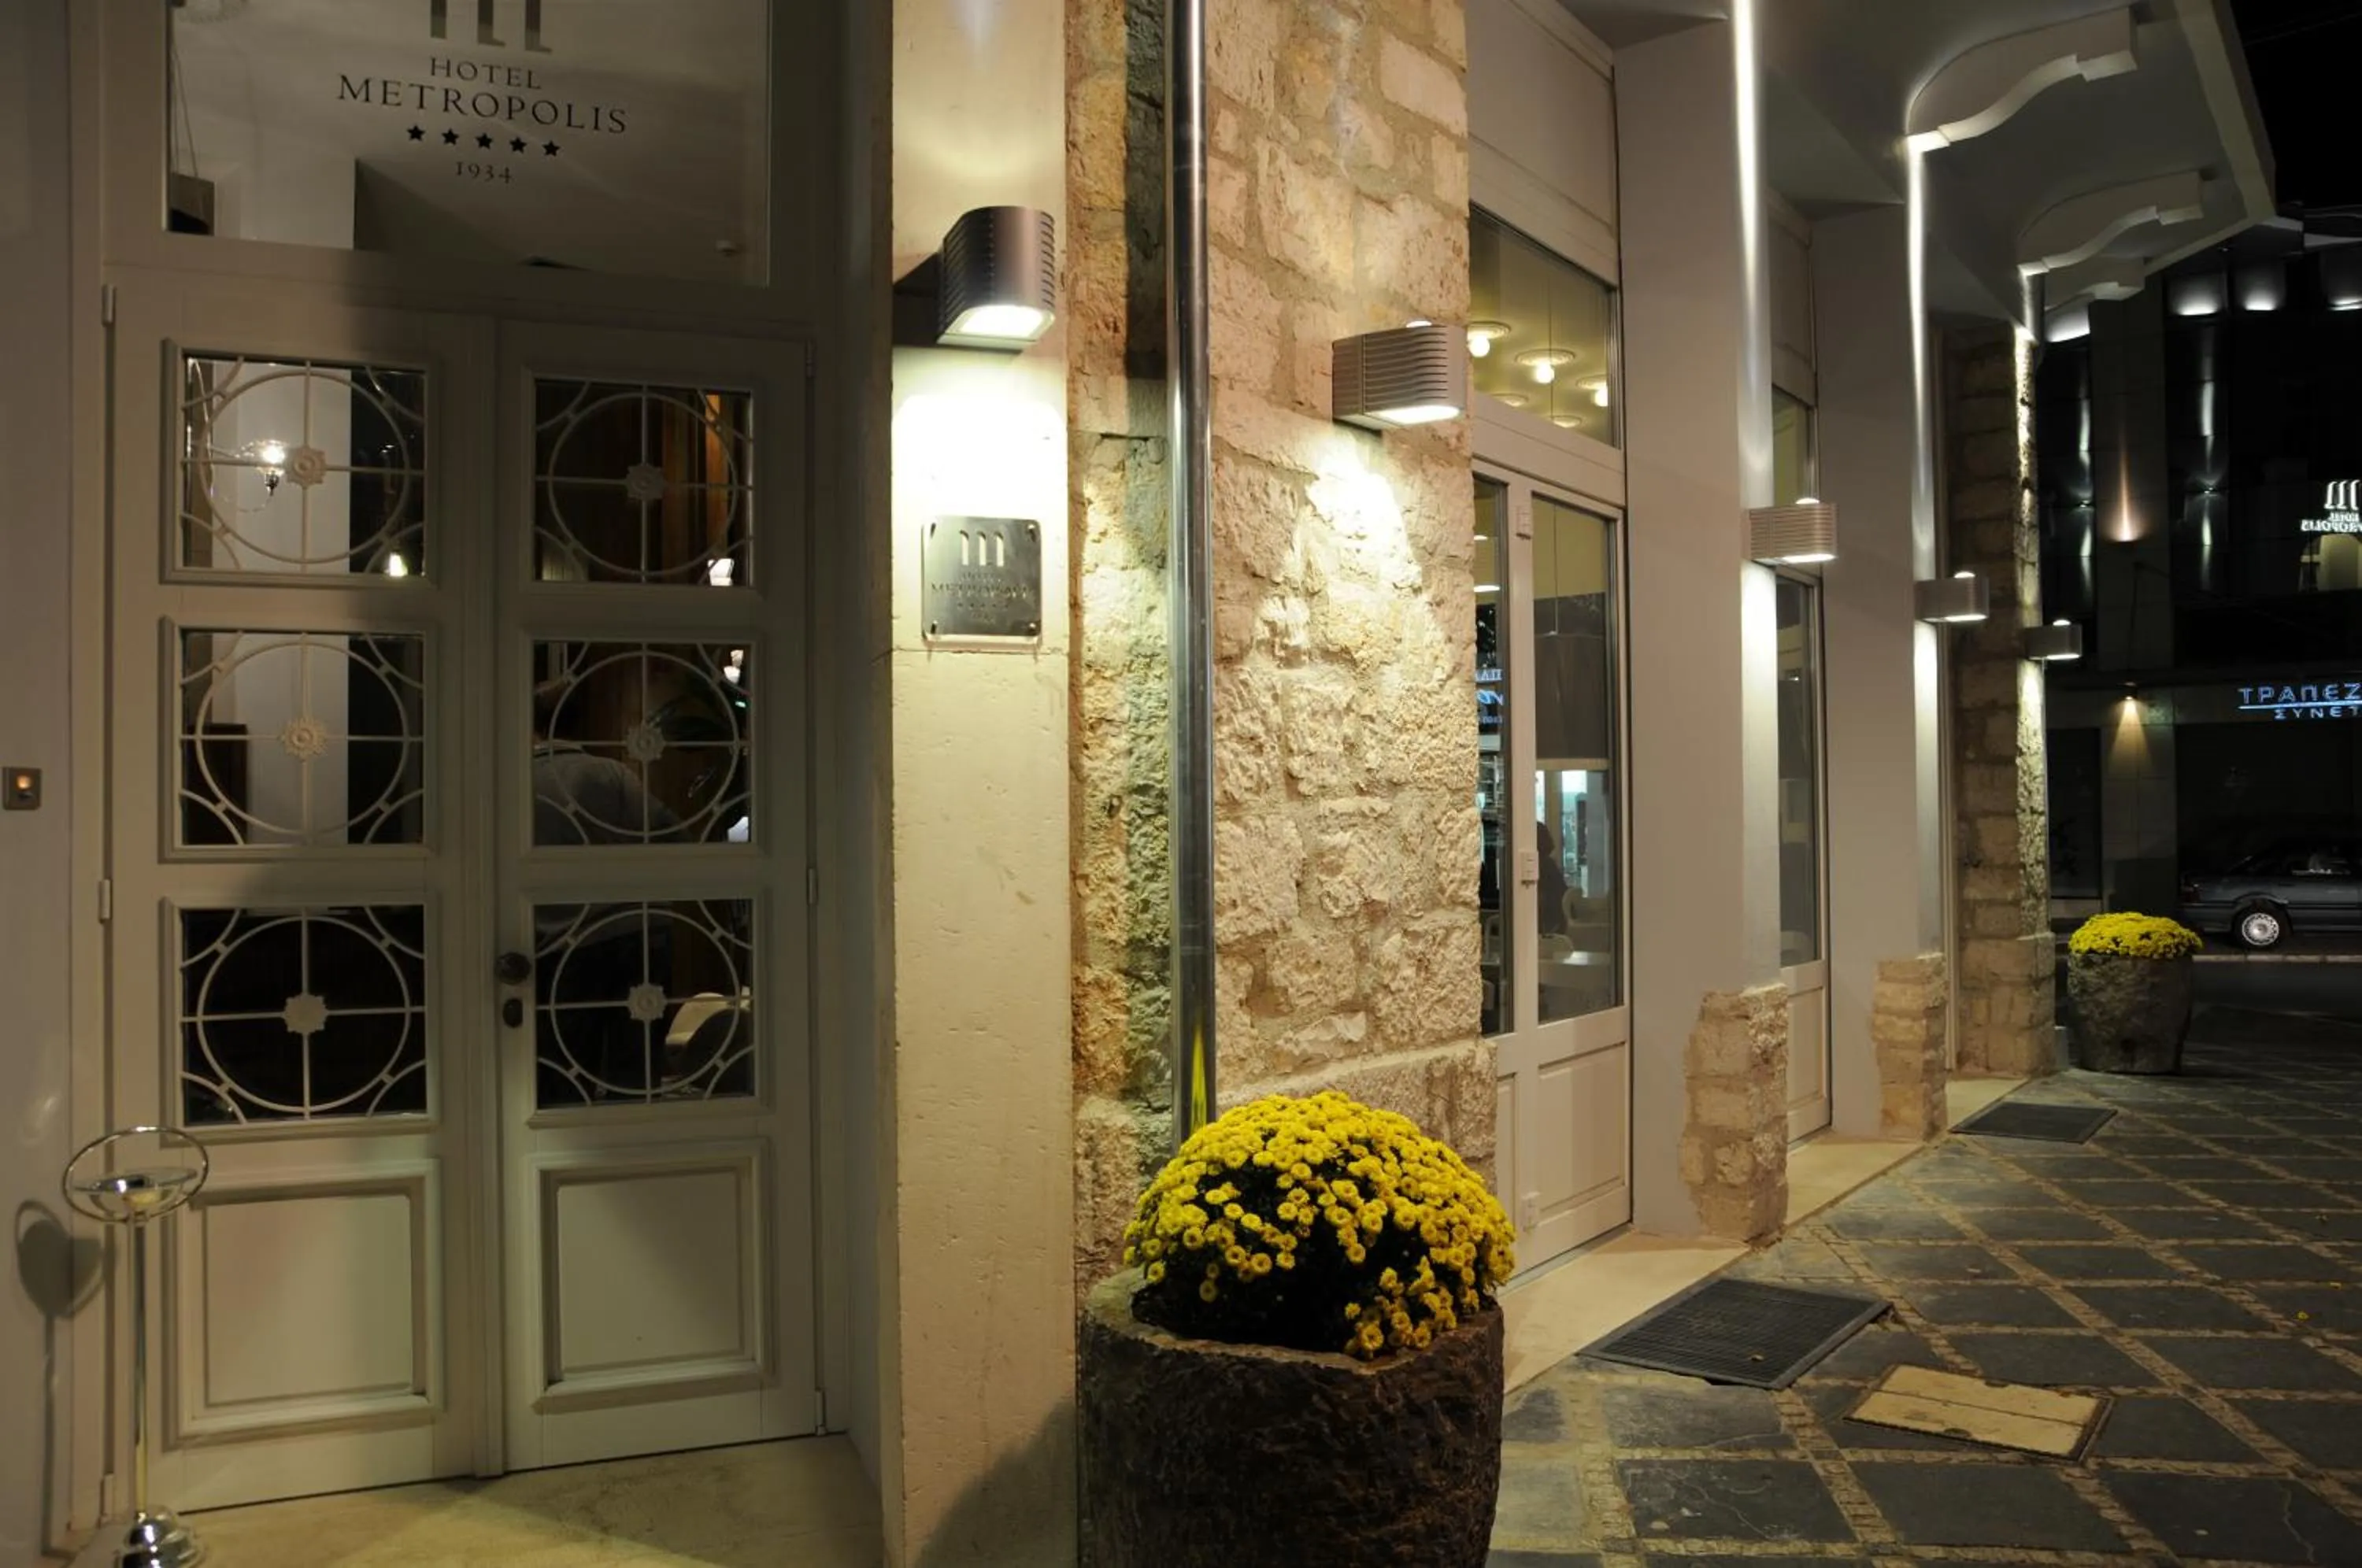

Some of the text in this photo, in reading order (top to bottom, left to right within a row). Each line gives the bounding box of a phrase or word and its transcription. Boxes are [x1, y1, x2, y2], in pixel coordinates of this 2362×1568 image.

[430, 56, 542, 90] HOTEL
[337, 75, 628, 134] METROPOLIS
[456, 161, 513, 183] 1934
